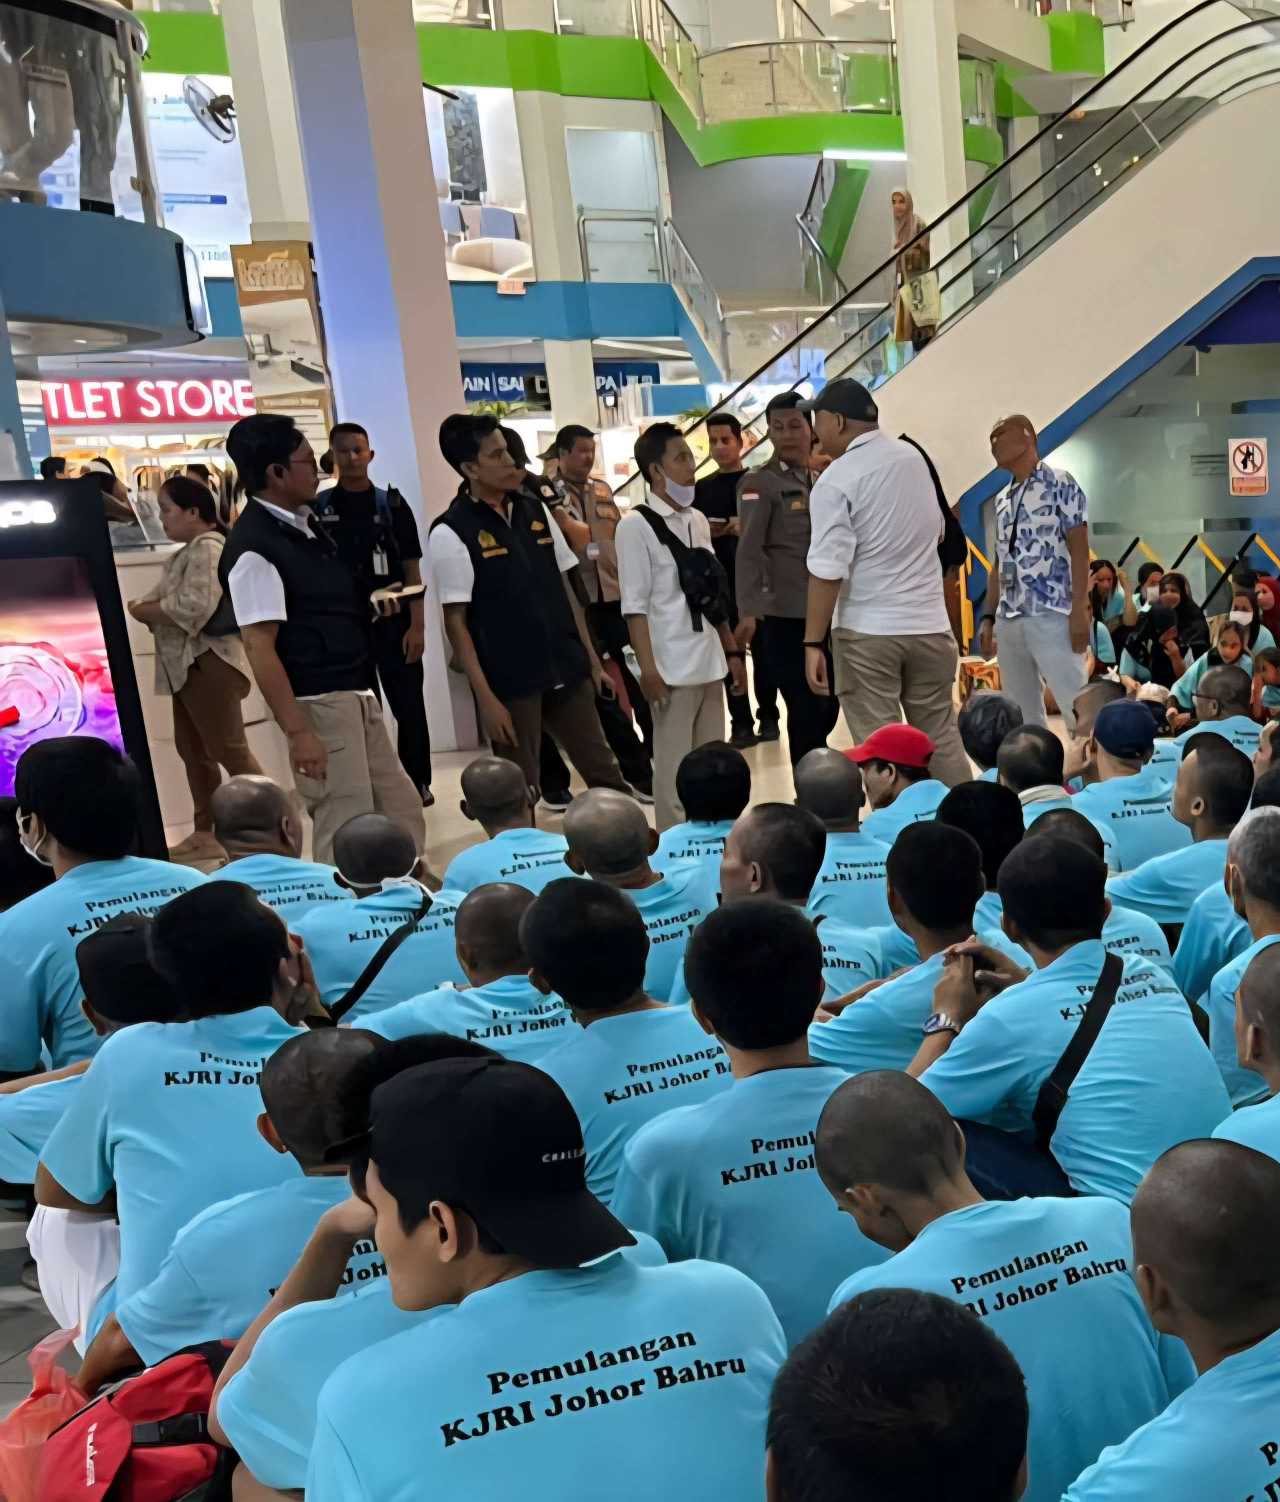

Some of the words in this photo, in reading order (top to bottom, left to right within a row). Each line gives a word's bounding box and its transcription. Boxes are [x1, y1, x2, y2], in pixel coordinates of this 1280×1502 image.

[463, 376, 491, 392] AIN
[41, 382, 124, 419] TLET
[136, 379, 257, 418] STORE
[651, 929, 684, 945] ohor
[465, 1020, 514, 1041] KJRI
[200, 1051, 265, 1069] Pemul
[626, 1045, 725, 1078] Pemulanga
[163, 1070, 222, 1087] KJRI
[603, 1079, 655, 1105] KJRI
[658, 1068, 711, 1091] Johor
[750, 1130, 815, 1155] Pemul
[720, 1160, 778, 1186] KJRI
[341, 1262, 388, 1286] Joh
[949, 1238, 1089, 1295] Pemulangan
[962, 1301, 989, 1321] RI
[992, 1278, 1060, 1312] Johor
[1064, 1254, 1128, 1286] Bahru
[486, 1329, 697, 1396] Pemulangan
[439, 1400, 536, 1448] KJRI
[544, 1378, 647, 1418] Johor
[654, 1356, 747, 1391] Bahru
